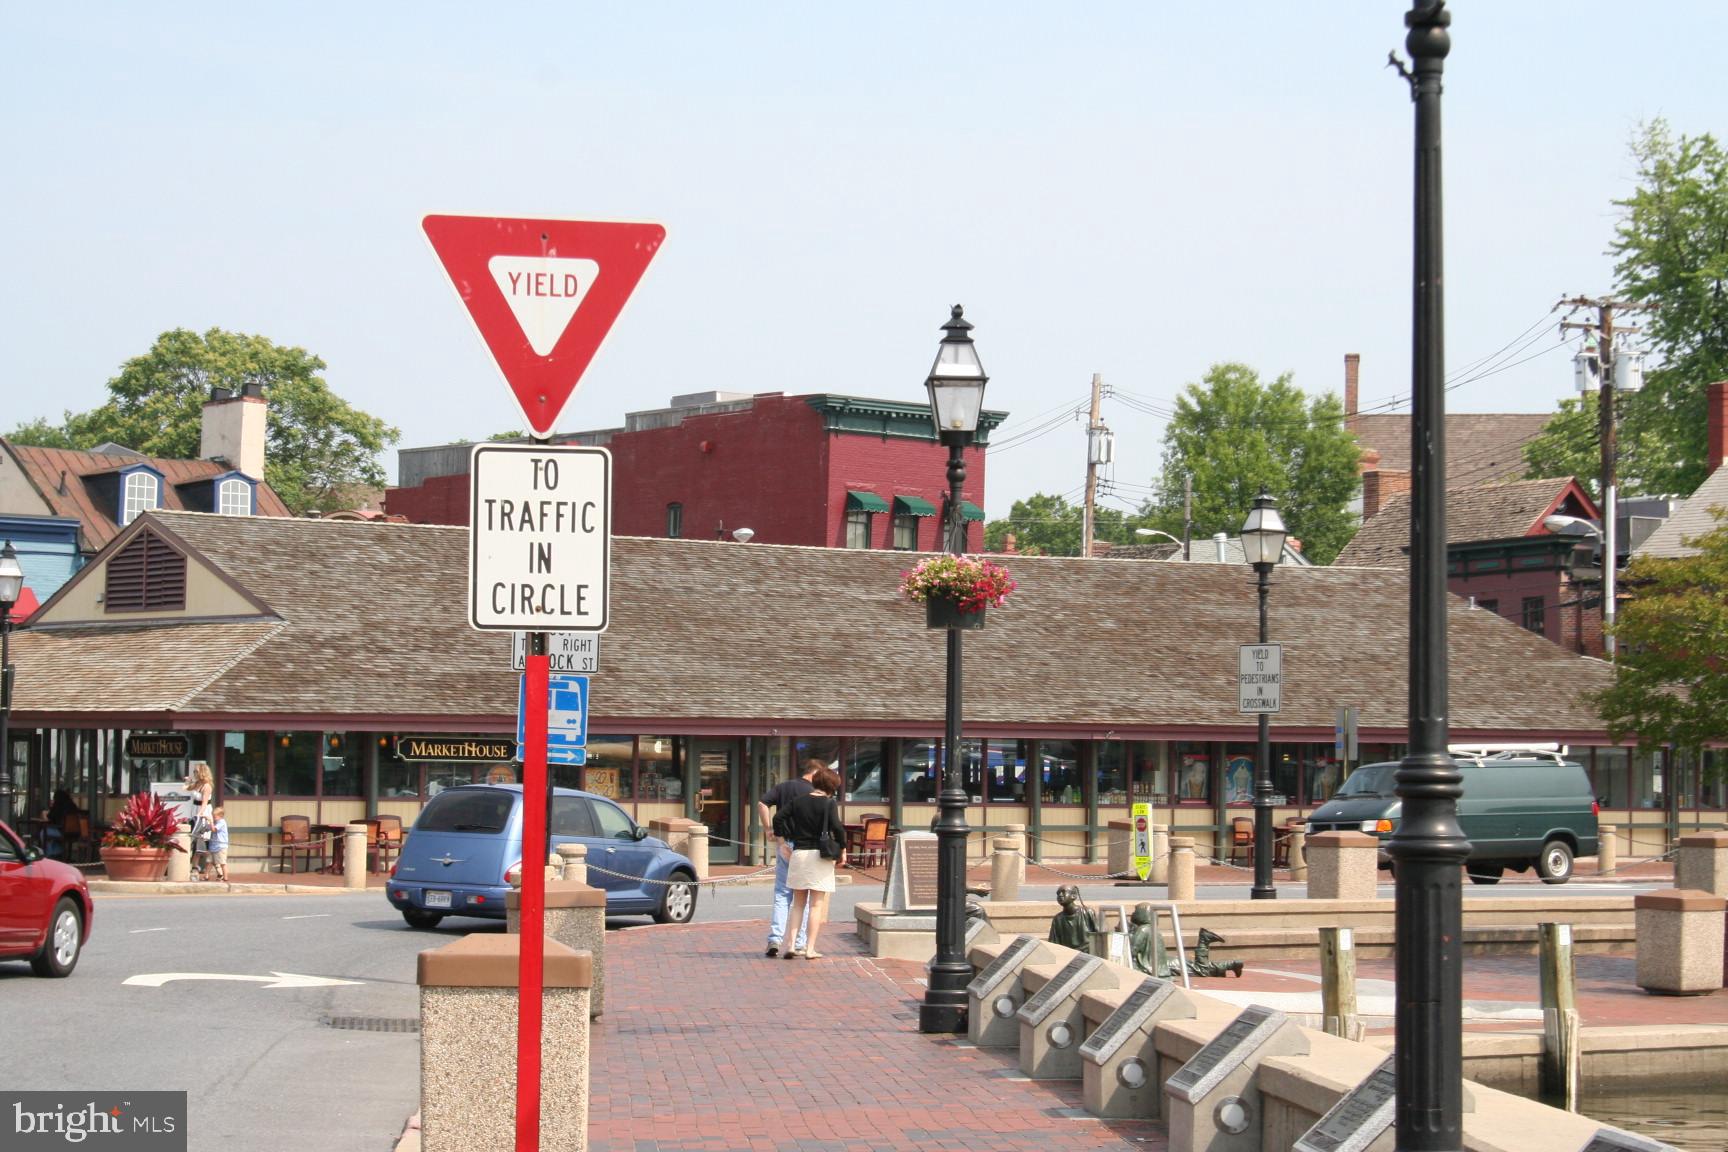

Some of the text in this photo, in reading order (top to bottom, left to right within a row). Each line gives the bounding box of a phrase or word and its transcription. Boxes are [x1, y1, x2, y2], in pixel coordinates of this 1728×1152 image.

[508, 272, 578, 298] YIELD
[531, 458, 559, 490] TO
[484, 499, 597, 534] TRAFFIC
[529, 542, 552, 574] IN
[492, 582, 589, 616] CIRCLE
[563, 638, 593, 652] RIGHT
[549, 653, 574, 670] OCK
[582, 657, 594, 670] ST
[1251, 648, 1269, 660] YIELD
[1256, 661, 1264, 671] TO
[1240, 673, 1279, 685] PEDESTRIANS
[1257, 686, 1263, 696] IN
[1242, 698, 1277, 709] CROSSWALK
